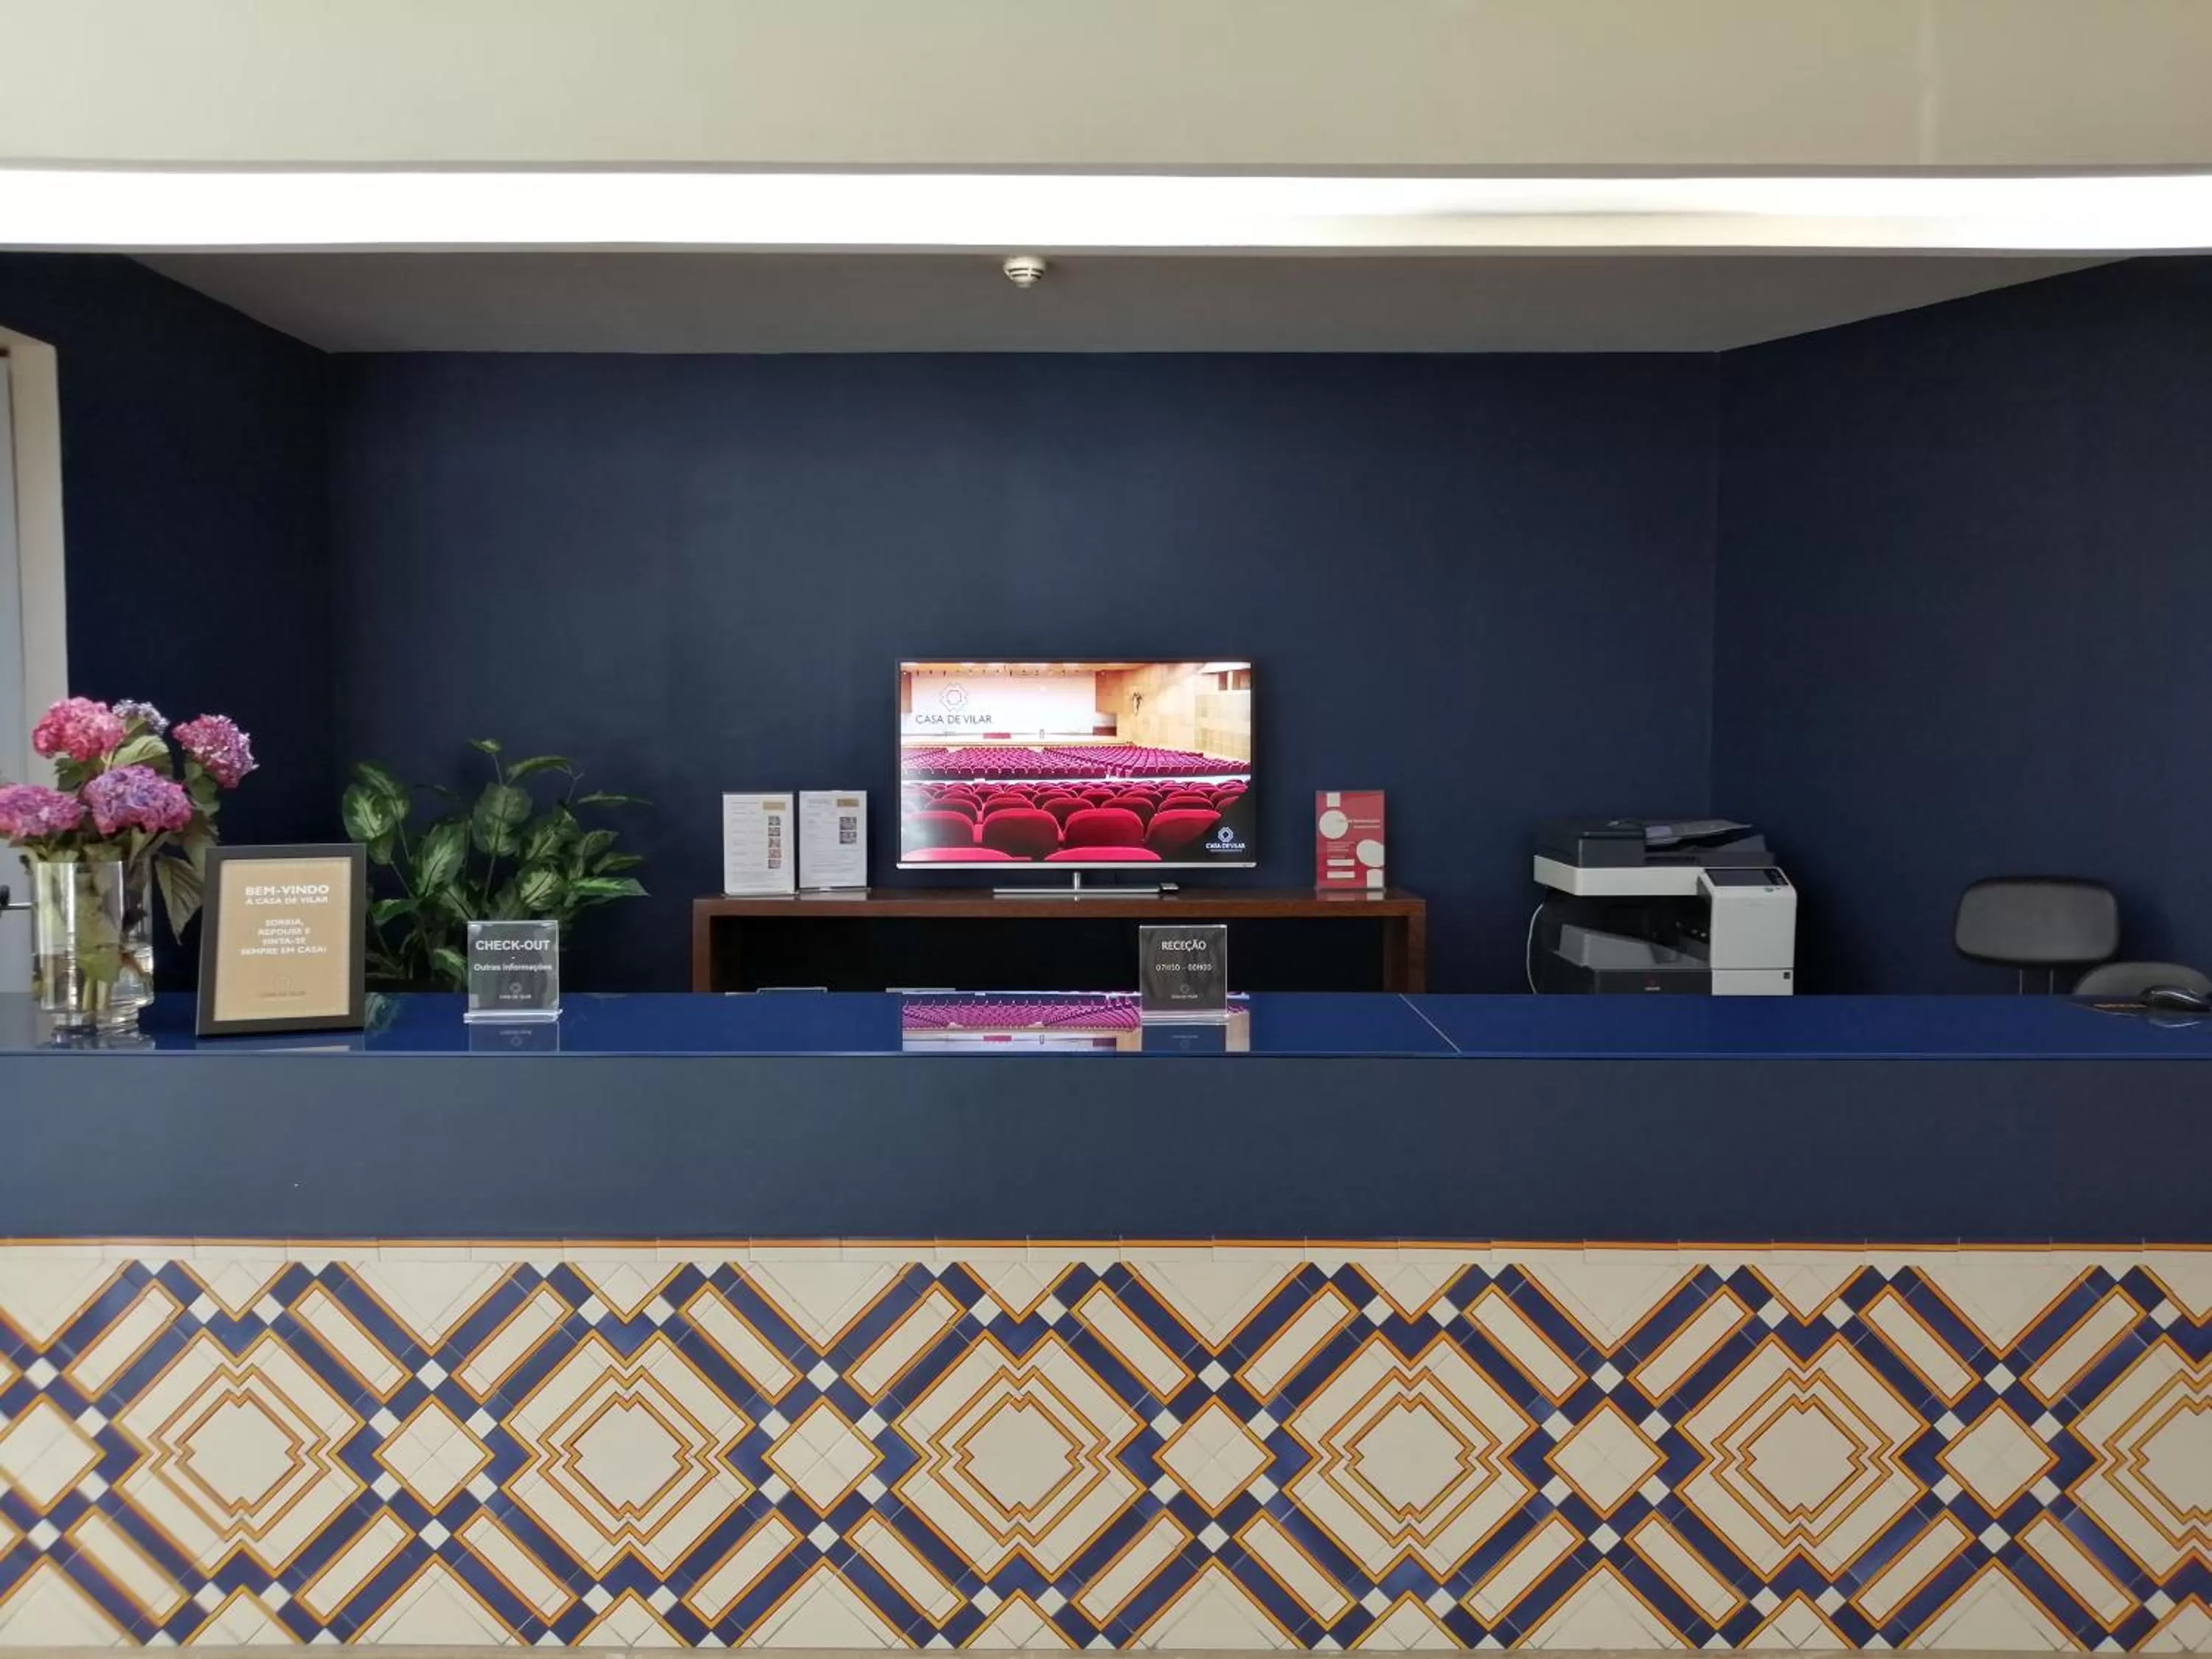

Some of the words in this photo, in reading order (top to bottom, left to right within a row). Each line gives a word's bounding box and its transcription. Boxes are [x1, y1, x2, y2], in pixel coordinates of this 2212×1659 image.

[915, 714, 945, 724] CASA
[947, 714, 961, 724] DE
[962, 714, 992, 724] VILAR
[245, 885, 330, 896] BEM-VINDO
[255, 897, 282, 905] CASA
[475, 940, 551, 951] CHECK-OUT
[1161, 939, 1207, 952] RECEÇÃO
